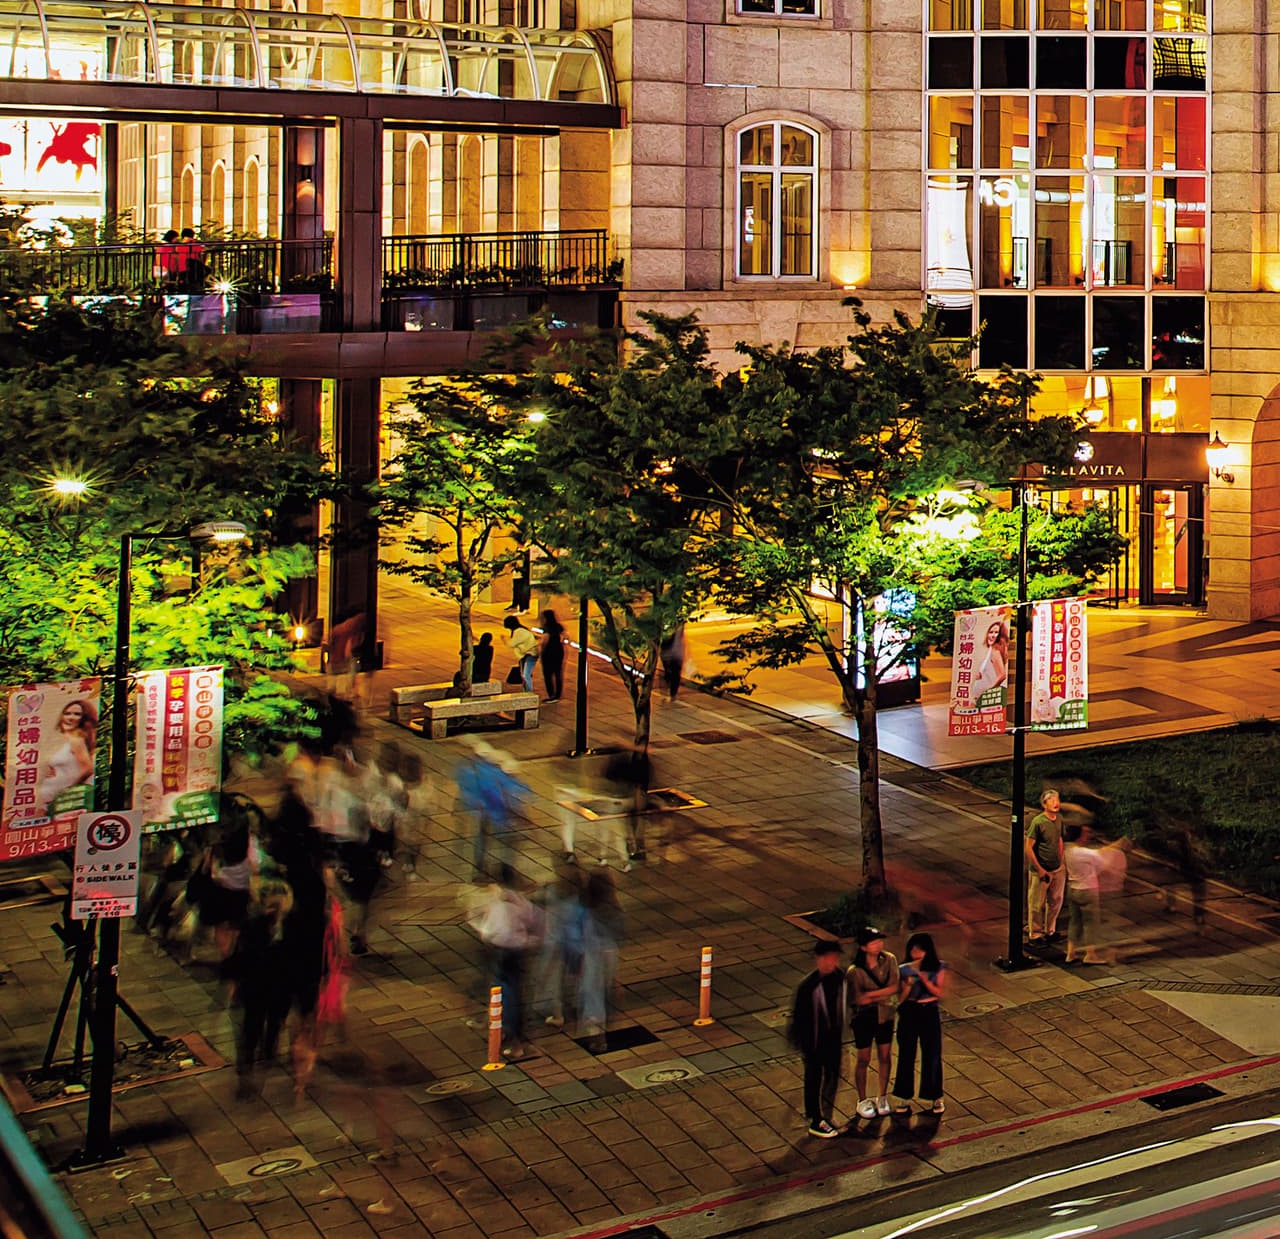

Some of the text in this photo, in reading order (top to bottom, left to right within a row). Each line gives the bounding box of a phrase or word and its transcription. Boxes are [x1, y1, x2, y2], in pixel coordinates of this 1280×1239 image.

[1043, 465, 1124, 475] BLLAVITA
[957, 642, 974, 698] 婦幼用品
[17, 717, 41, 726] 台北
[13, 727, 41, 806] 婦幼用品
[87, 874, 135, 883] SIDEWALK
